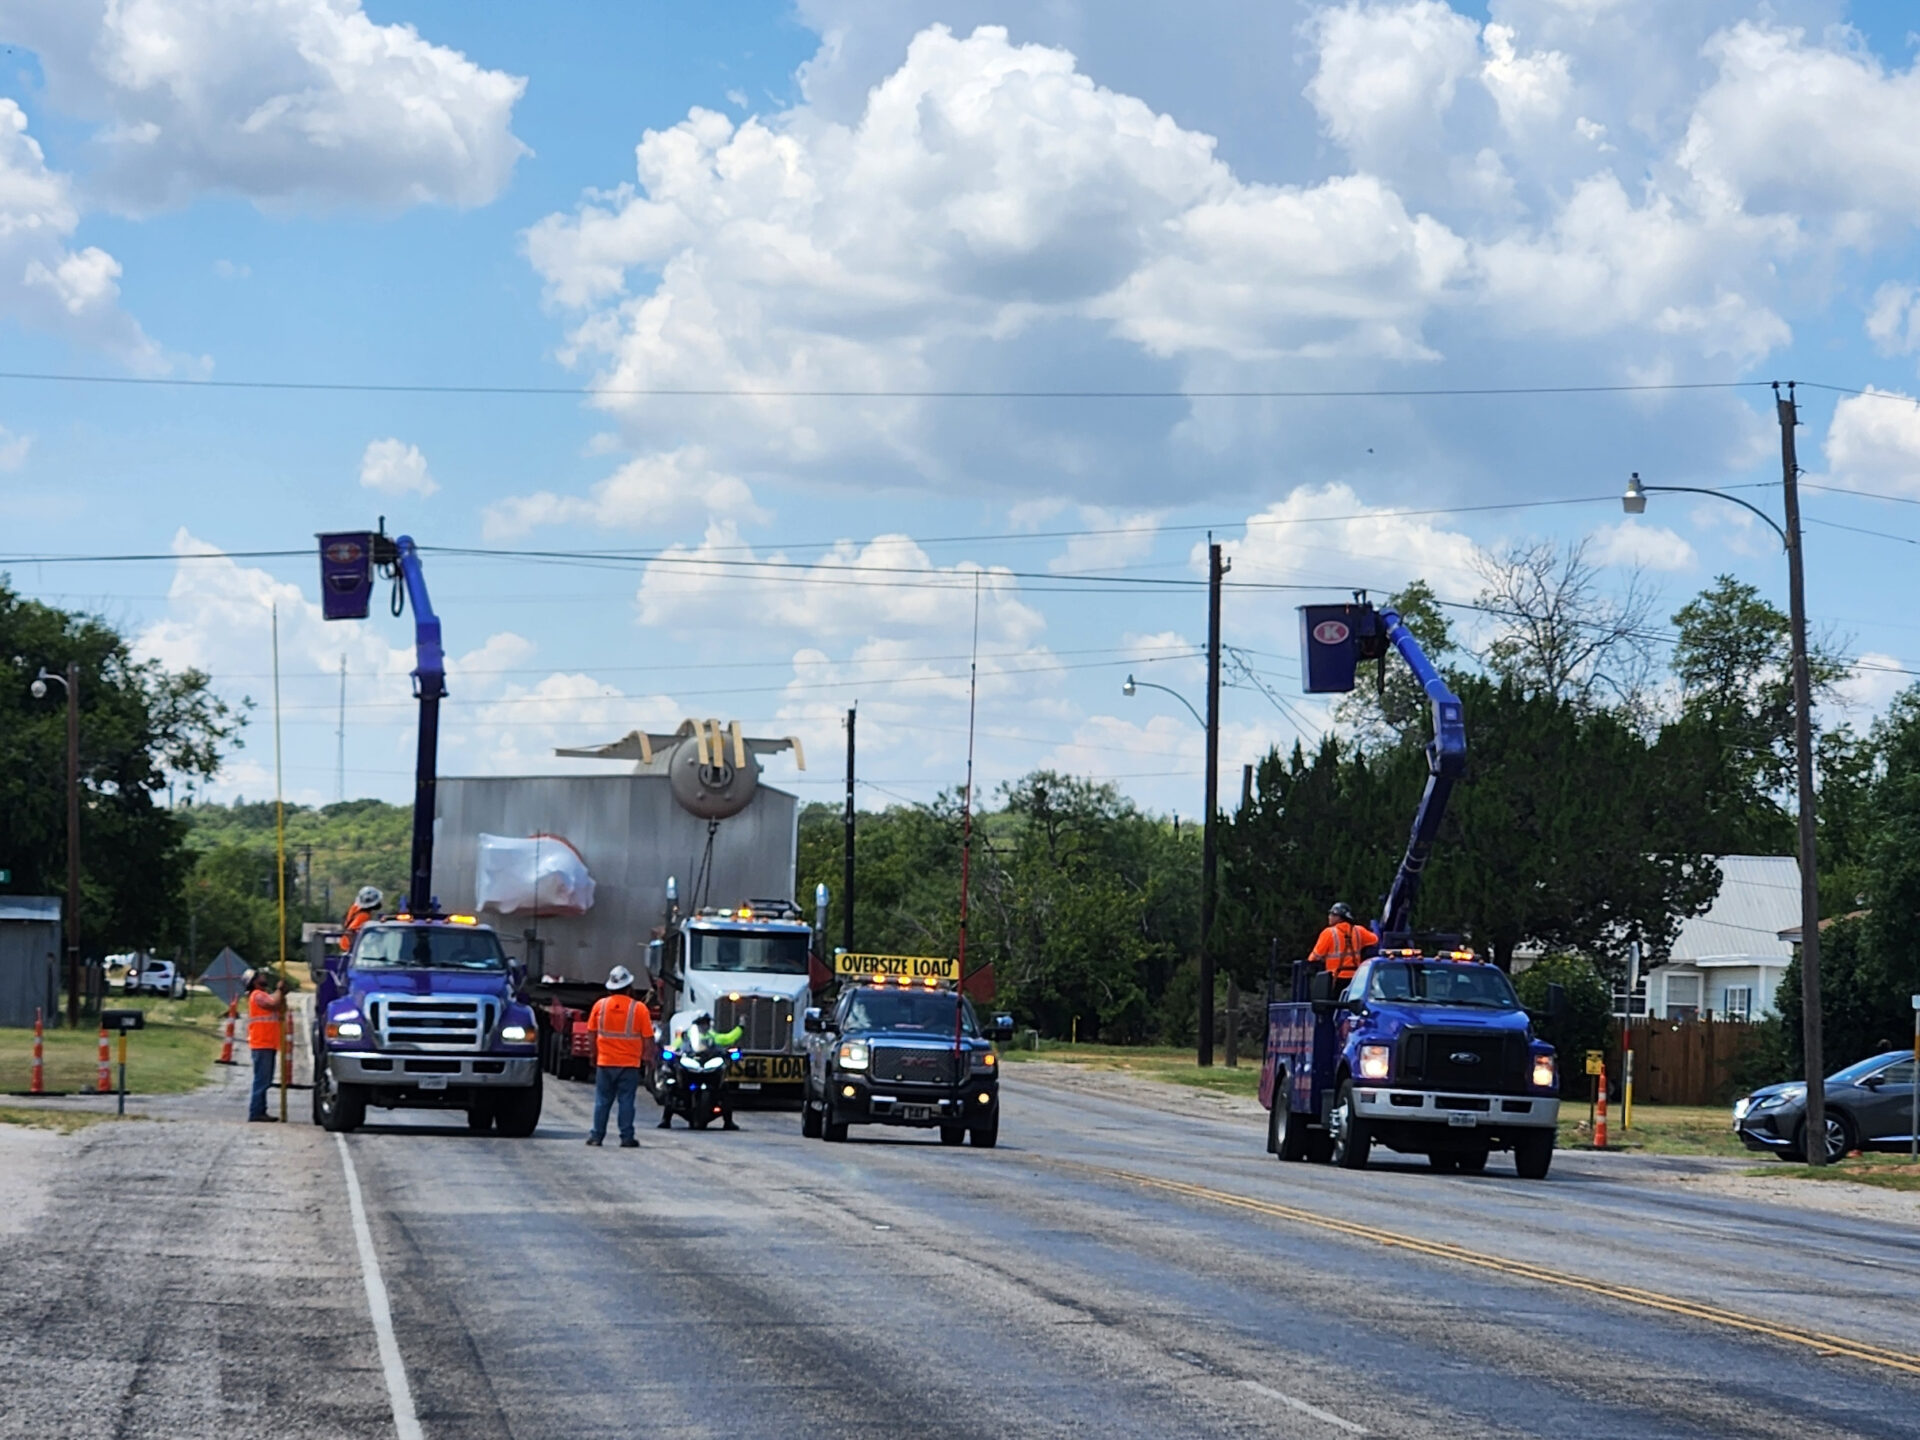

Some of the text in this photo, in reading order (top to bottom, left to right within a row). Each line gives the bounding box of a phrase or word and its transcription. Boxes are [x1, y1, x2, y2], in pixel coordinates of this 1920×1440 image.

[1324, 624, 1340, 641] K
[842, 955, 952, 977] OVERSIZE LOAD
[771, 1057, 806, 1080] LOA
